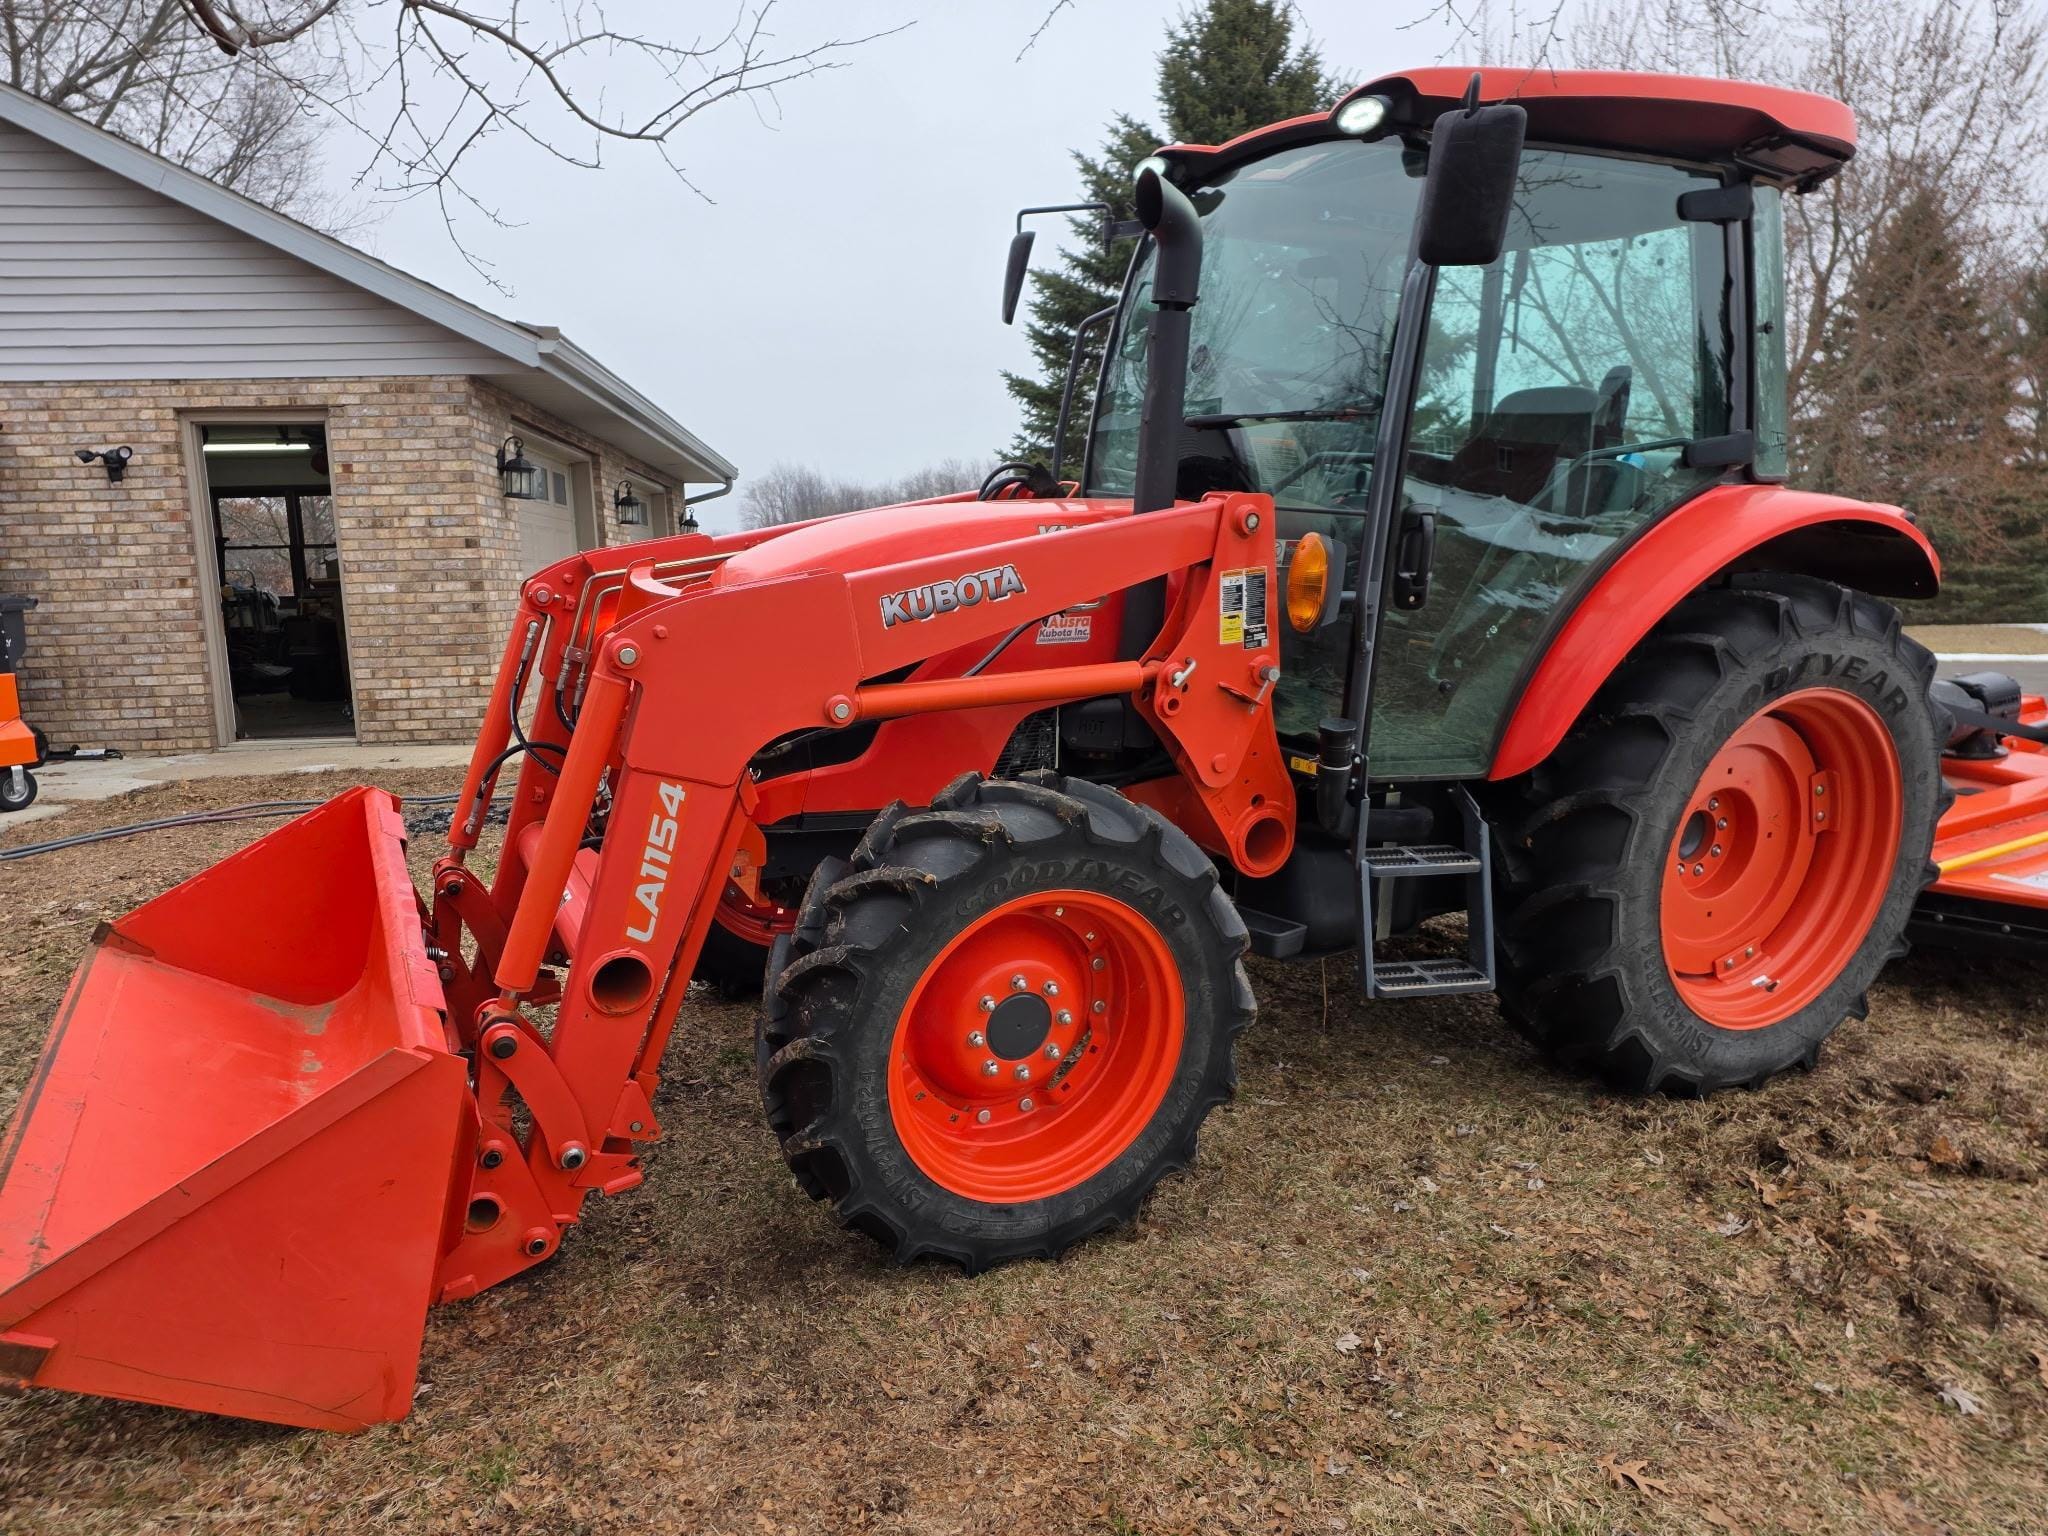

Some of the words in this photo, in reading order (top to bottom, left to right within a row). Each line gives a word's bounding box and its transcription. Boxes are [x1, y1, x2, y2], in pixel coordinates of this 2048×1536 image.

[880, 564, 1026, 629] KUBOTA
[1039, 628, 1073, 638] Kubota
[1074, 627, 1089, 637] Inc.
[1048, 615, 1090, 629] Ausra
[1078, 719, 1105, 736] HOT
[626, 781, 686, 943] LA1154
[957, 857, 1188, 927] GOODYEAR
